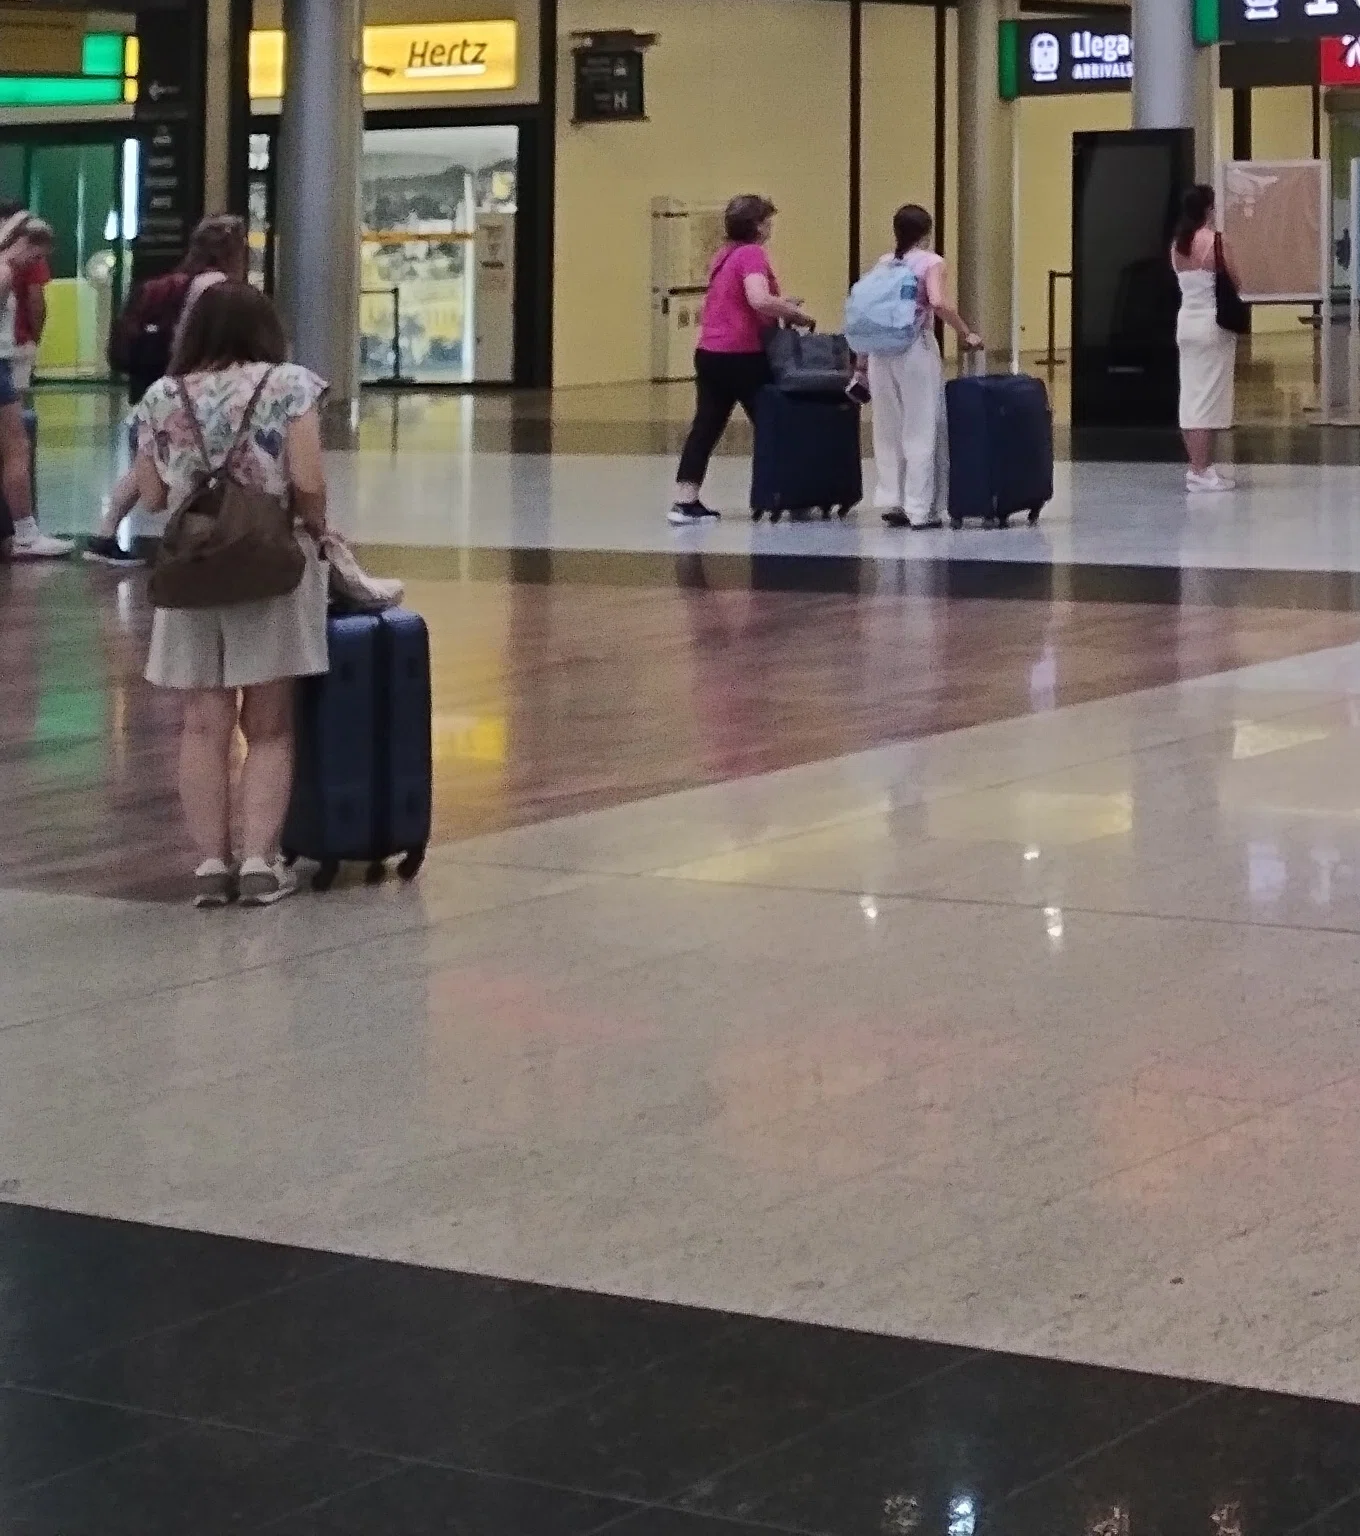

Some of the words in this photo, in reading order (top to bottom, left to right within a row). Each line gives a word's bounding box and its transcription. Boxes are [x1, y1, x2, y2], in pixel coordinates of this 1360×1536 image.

[408, 39, 488, 68] Hertz
[1071, 30, 1133, 62] Llega
[1072, 61, 1134, 80] ARRIVALS
